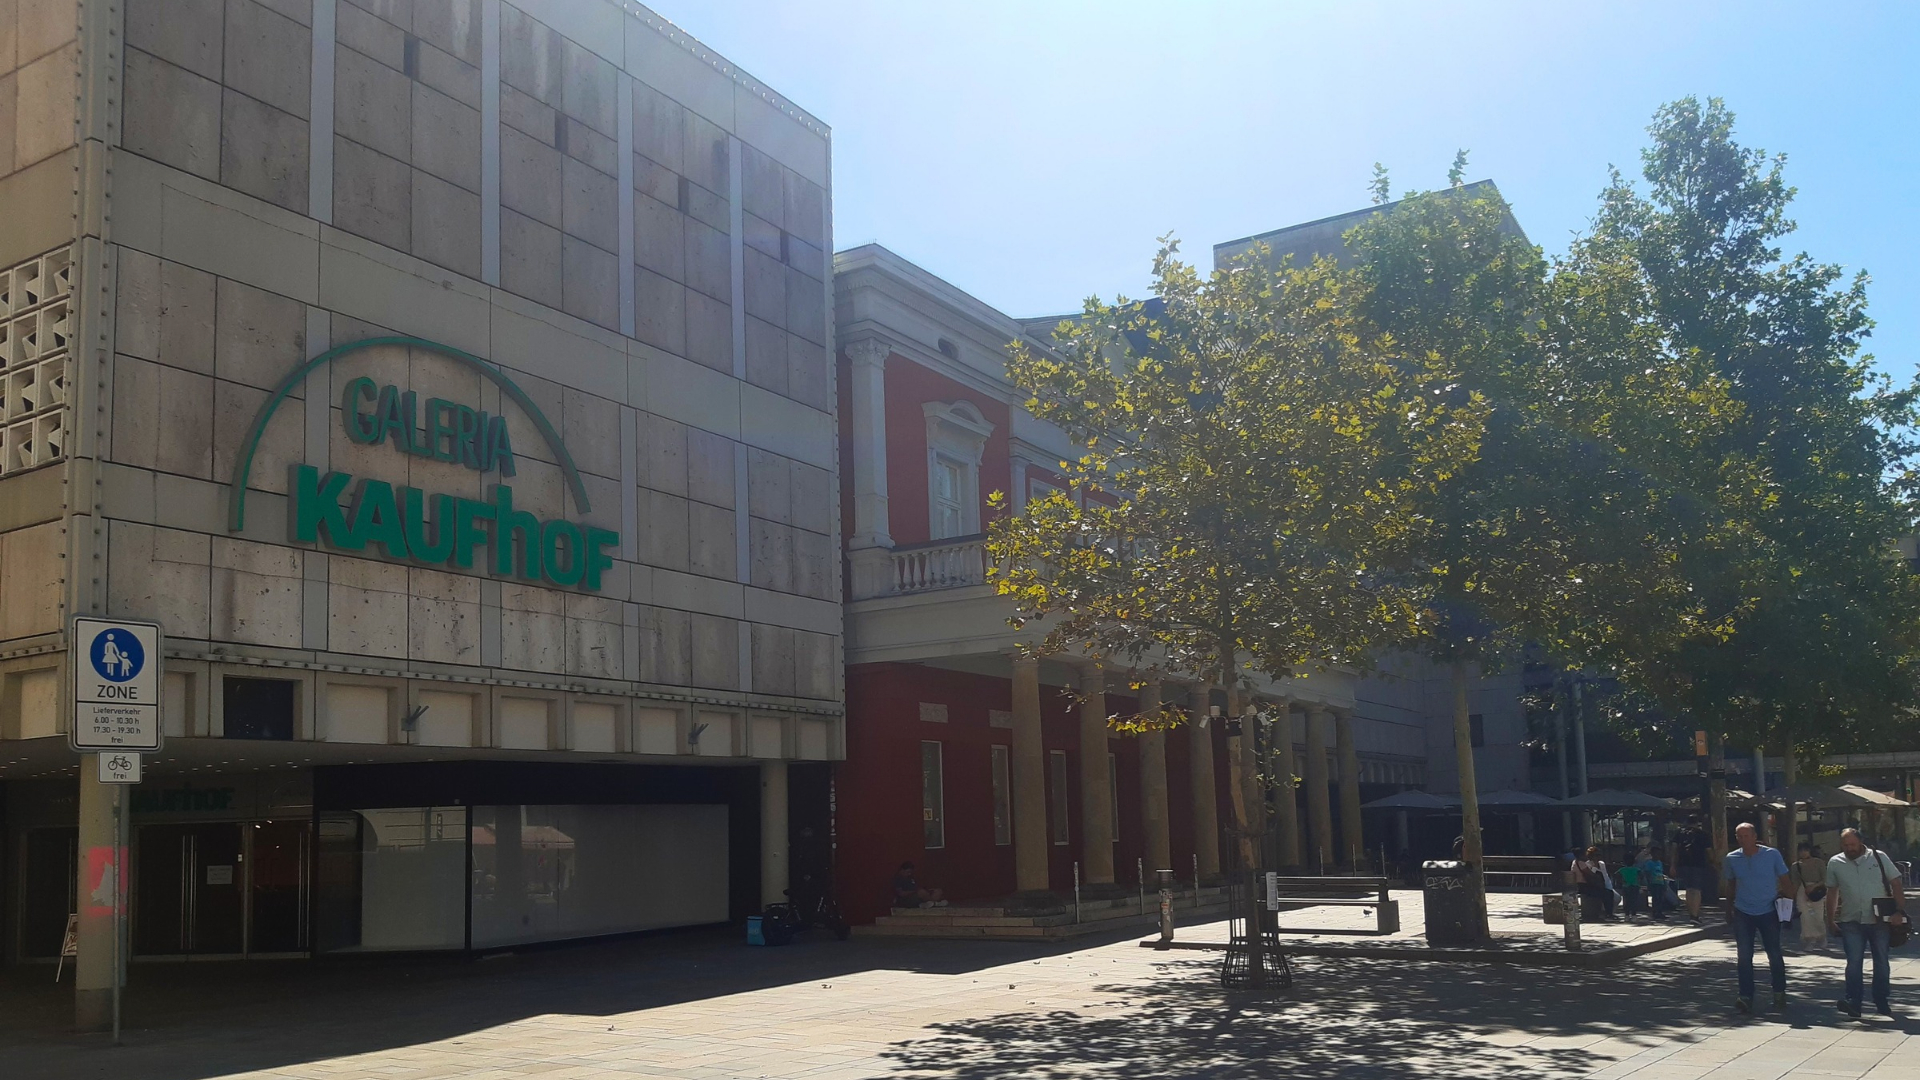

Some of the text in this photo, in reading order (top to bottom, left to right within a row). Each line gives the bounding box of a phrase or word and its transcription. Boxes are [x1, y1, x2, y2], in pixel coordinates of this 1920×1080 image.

[341, 376, 516, 477] GALERIA
[97, 685, 138, 699] ZONE
[93, 706, 141, 715] Lieferverkehr
[95, 716, 109, 724] 6.00
[117, 717, 134, 725] 10.30
[93, 726, 111, 734] 17.30
[111, 736, 123, 744] frei
[113, 771, 127, 780] frei
